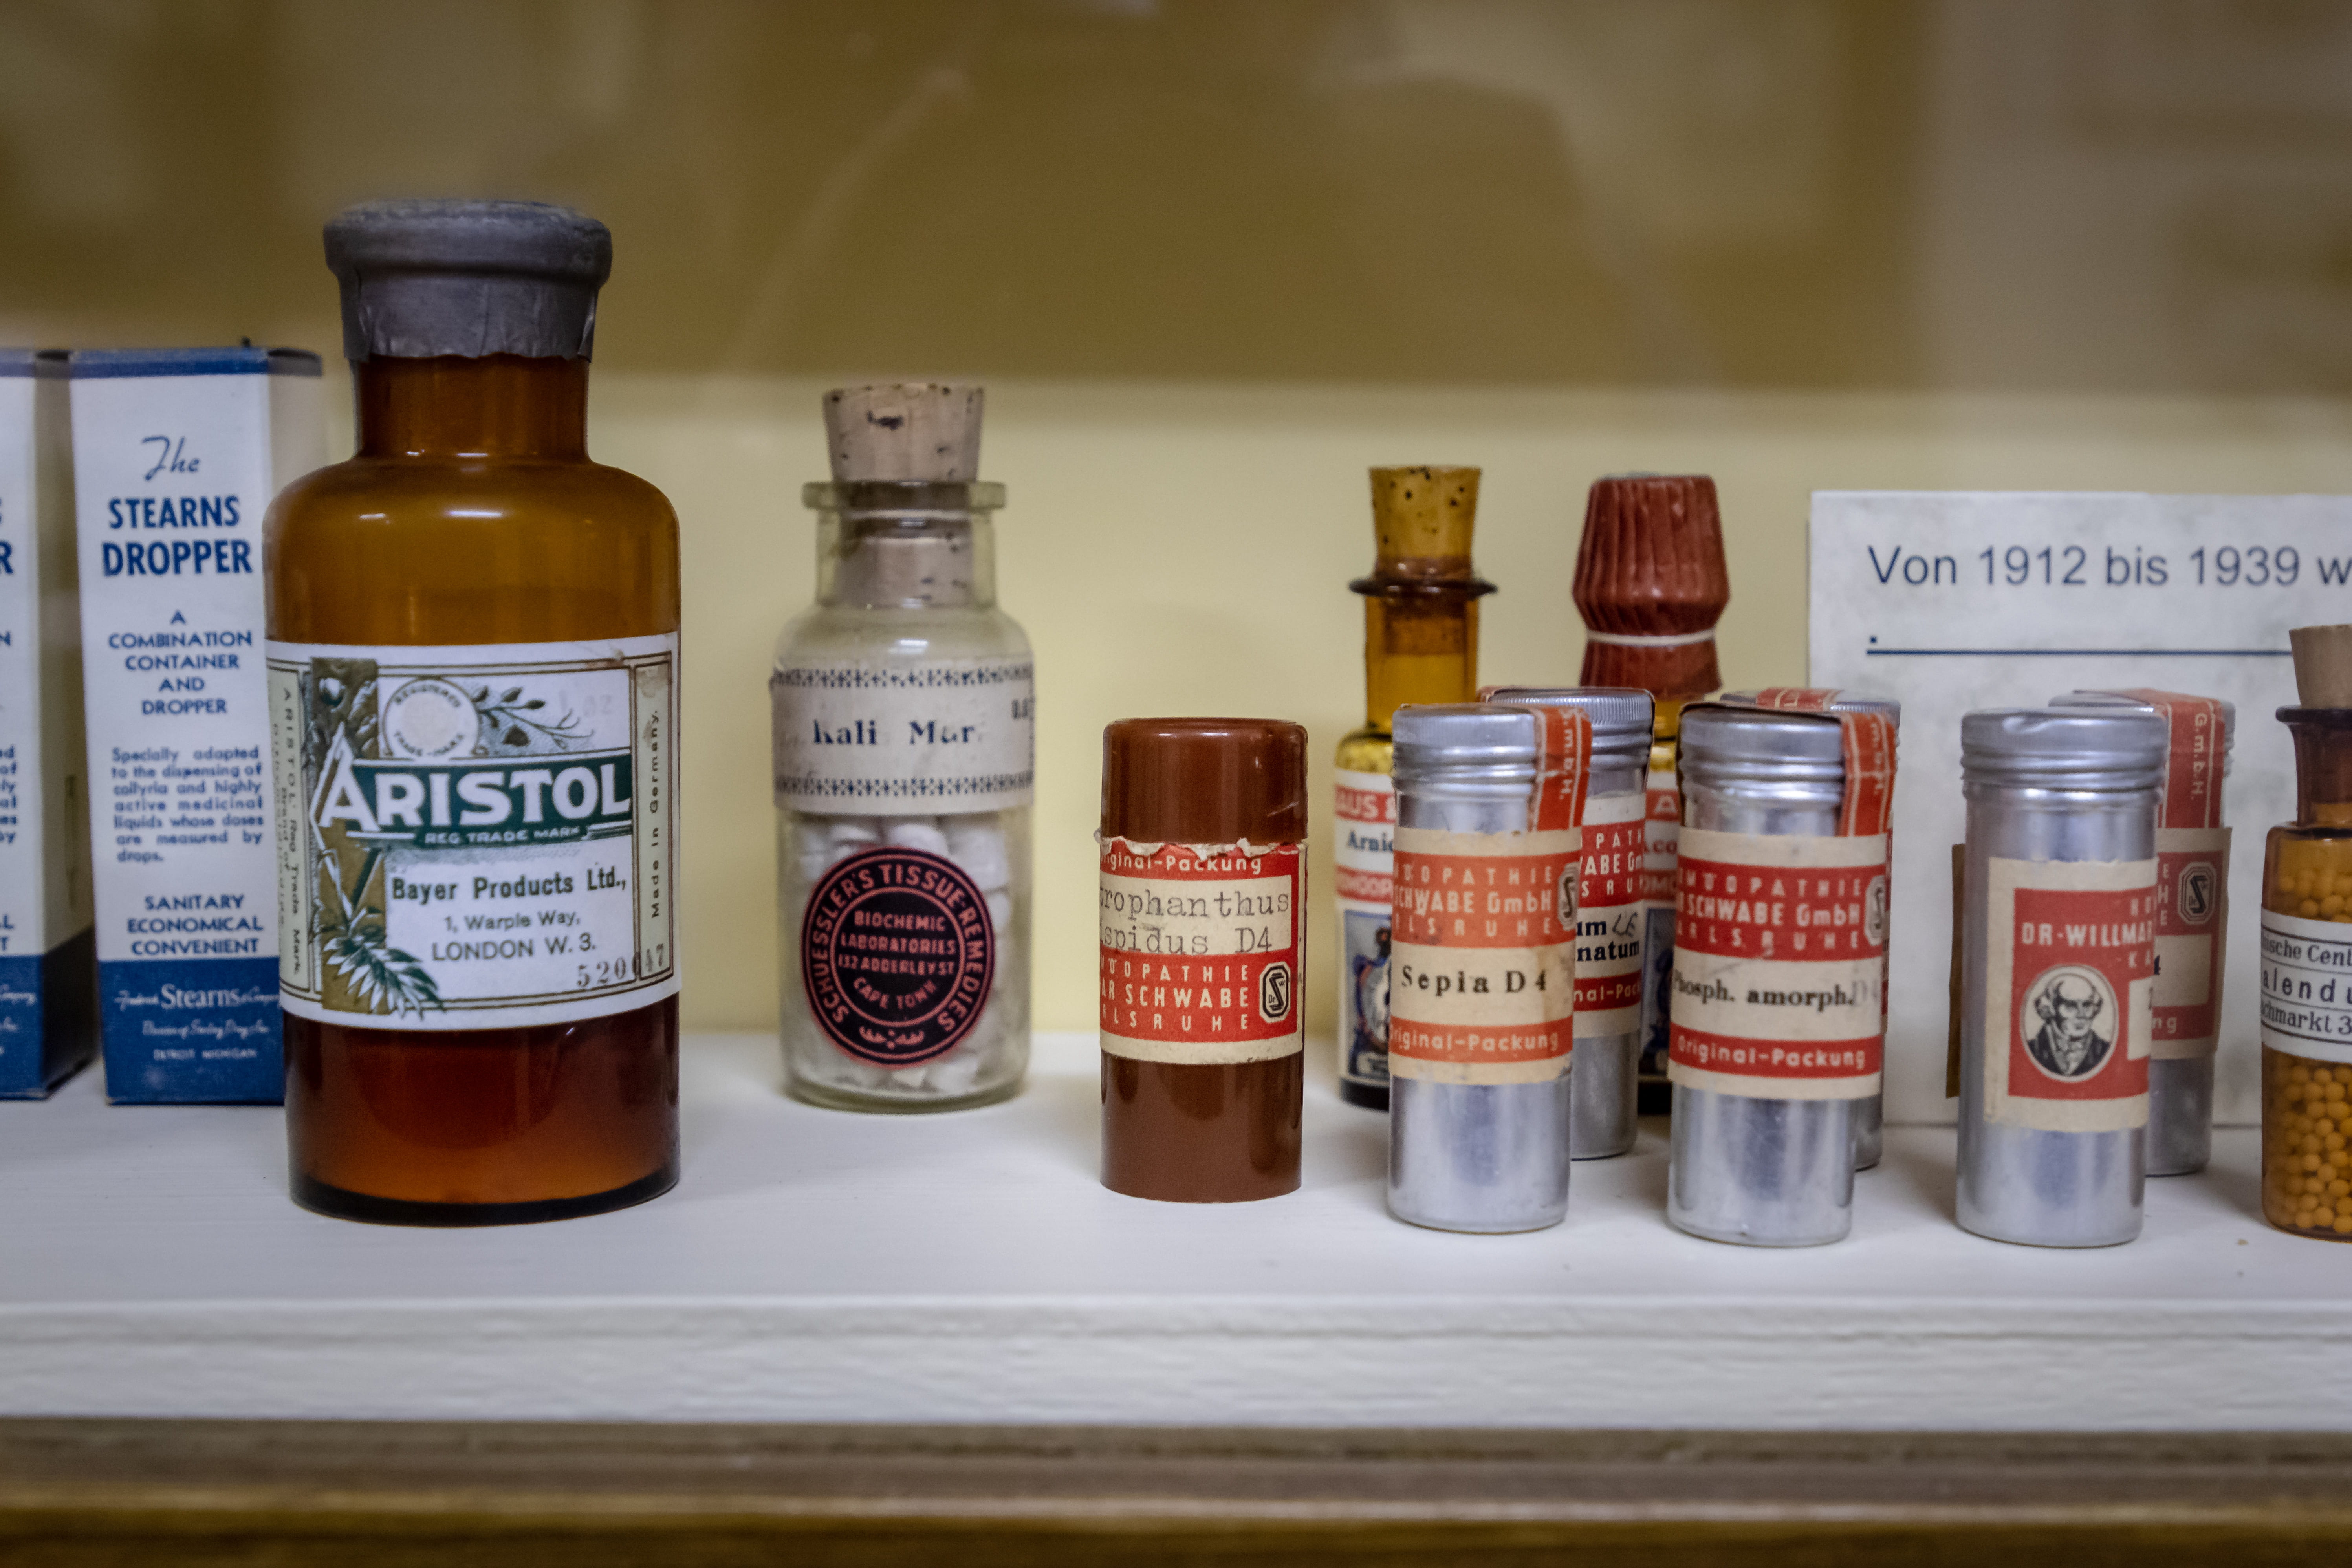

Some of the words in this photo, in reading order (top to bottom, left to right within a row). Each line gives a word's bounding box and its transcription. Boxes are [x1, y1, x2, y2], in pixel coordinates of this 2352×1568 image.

[141, 435, 200, 481] The
[109, 495, 240, 529] STEARNS
[102, 540, 253, 577] DROPPER
[1867, 545, 1956, 586] Von
[1979, 545, 2087, 586] 1912
[2106, 545, 2169, 586] bis
[2189, 545, 2300, 586] 1939
[170, 609, 186, 625] A
[108, 630, 252, 649] COMBINATION
[125, 654, 240, 670] CONTAINER
[159, 676, 205, 692] AND
[142, 698, 227, 715] DROPPER
[113, 747, 178, 766] Specially
[194, 745, 258, 761] adapted
[111, 766, 128, 779] to
[134, 766, 156, 778] the
[162, 764, 239, 779] dispensing
[245, 762, 262, 775] of
[312, 722, 632, 831] ARISTOL
[177, 780, 205, 794] and
[214, 779, 261, 794] highly
[115, 797, 166, 811] active
[178, 796, 262, 810] medicinal
[114, 814, 162, 830] liquids
[169, 814, 214, 828] whose
[222, 812, 263, 827] doses
[116, 835, 141, 845] are
[156, 830, 228, 844] measured
[242, 829, 262, 844] by
[467, 830, 528, 843] TRADE
[534, 826, 580, 838] MARK
[392, 877, 458, 904] Bayer
[473, 872, 573, 899] Products
[587, 866, 626, 890] Ltd.,
[651, 860, 659, 918] Made
[145, 894, 244, 910] SANITARY
[1487, 890, 1552, 914] GmbH
[1688, 893, 1784, 926] SCHWABE
[1796, 903, 1861, 927] GmbH
[127, 916, 264, 934] ECONOMICAL
[444, 916, 458, 933] 1,
[464, 912, 531, 931] Warple
[538, 910, 580, 927] Way,
[854, 910, 946, 931] BIOCHEMIC
[131, 938, 258, 956] CONVENIENT
[432, 940, 533, 962] LONDON
[546, 936, 573, 954] W.
[579, 932, 596, 951] 3.
[811, 868, 875, 1024] SCHUESSLER'S
[938, 905, 985, 1032] REMEDIES
[841, 932, 956, 956] LABORATORIES
[1100, 924, 1209, 954] spidus
[1235, 926, 1272, 954] D4
[838, 954, 858, 970] 132
[861, 957, 936, 975] ADDERLEY
[938, 960, 954, 976] ST
[853, 977, 888, 1009] CAPE
[897, 980, 937, 1009] TOWN
[1401, 965, 1490, 997] Sepia
[161, 984, 240, 1009] Stearns
[1125, 983, 1248, 1008] SCHWABE
[1746, 984, 1855, 1013] amorph.
[1678, 1035, 1865, 1070] Original-Packung
